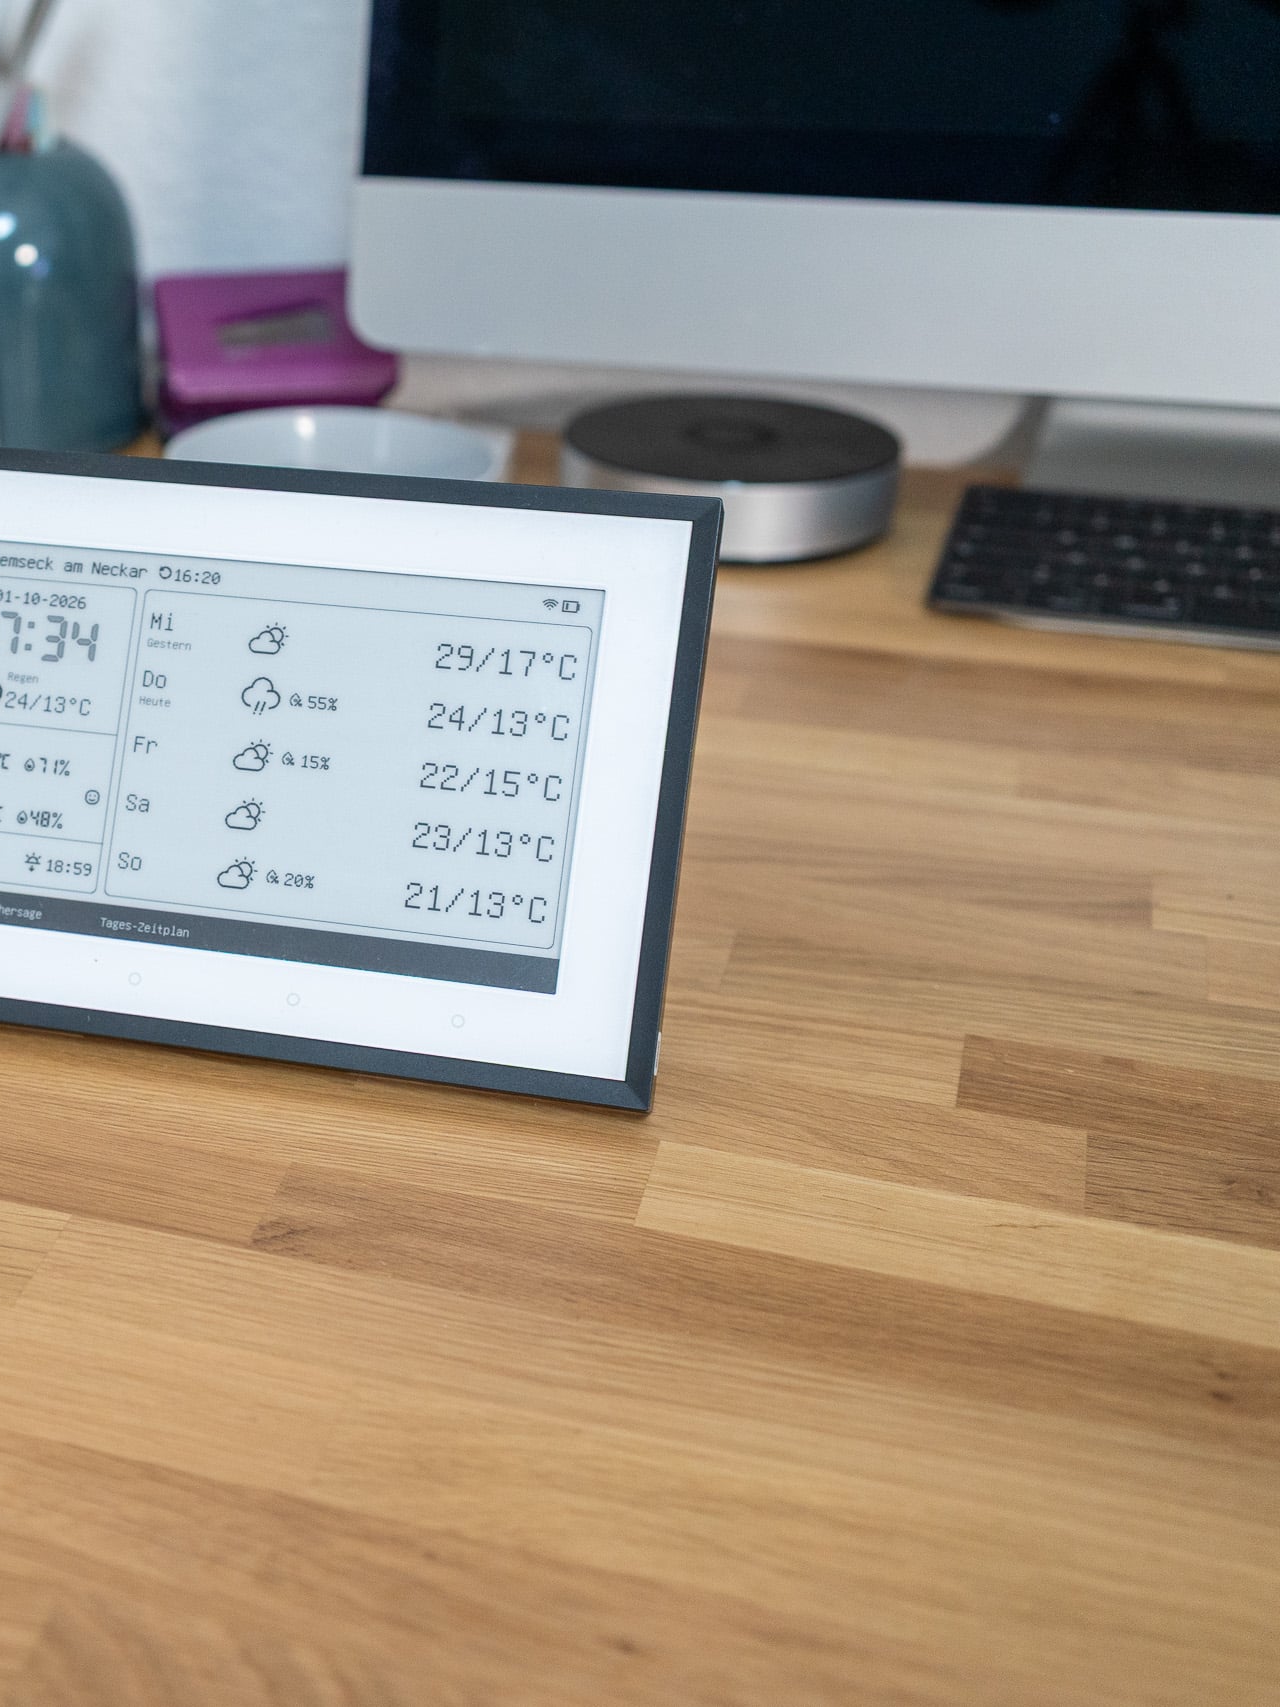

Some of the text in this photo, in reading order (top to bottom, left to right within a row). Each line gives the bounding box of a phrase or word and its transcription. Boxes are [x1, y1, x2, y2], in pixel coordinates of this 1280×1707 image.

[64, 561, 84, 574] am
[91, 561, 148, 579] Neckar
[174, 568, 222, 586] 16:20
[150, 612, 175, 632] Mi
[146, 638, 193, 652] Gestern
[435, 643, 578, 681] 29/17°C
[7, 671, 40, 685] Regen
[141, 669, 167, 690] Do
[4, 690, 93, 717] 24/13°C
[138, 695, 172, 709] Heute
[307, 695, 339, 712] 55%
[427, 702, 571, 741] 24/13°C
[132, 735, 159, 755] Fr
[39, 757, 72, 777] 71%
[301, 754, 331, 771] 15%
[419, 762, 563, 802] 22/15°C
[125, 793, 151, 813] Sa
[29, 811, 64, 830] 48%
[412, 822, 556, 863] 23/13°C
[45, 859, 93, 877] 18:59
[117, 851, 143, 871] So
[283, 872, 315, 890] 20%
[404, 882, 548, 924] 21/13°C
[99, 916, 190, 939] Tages-Zeitplan
